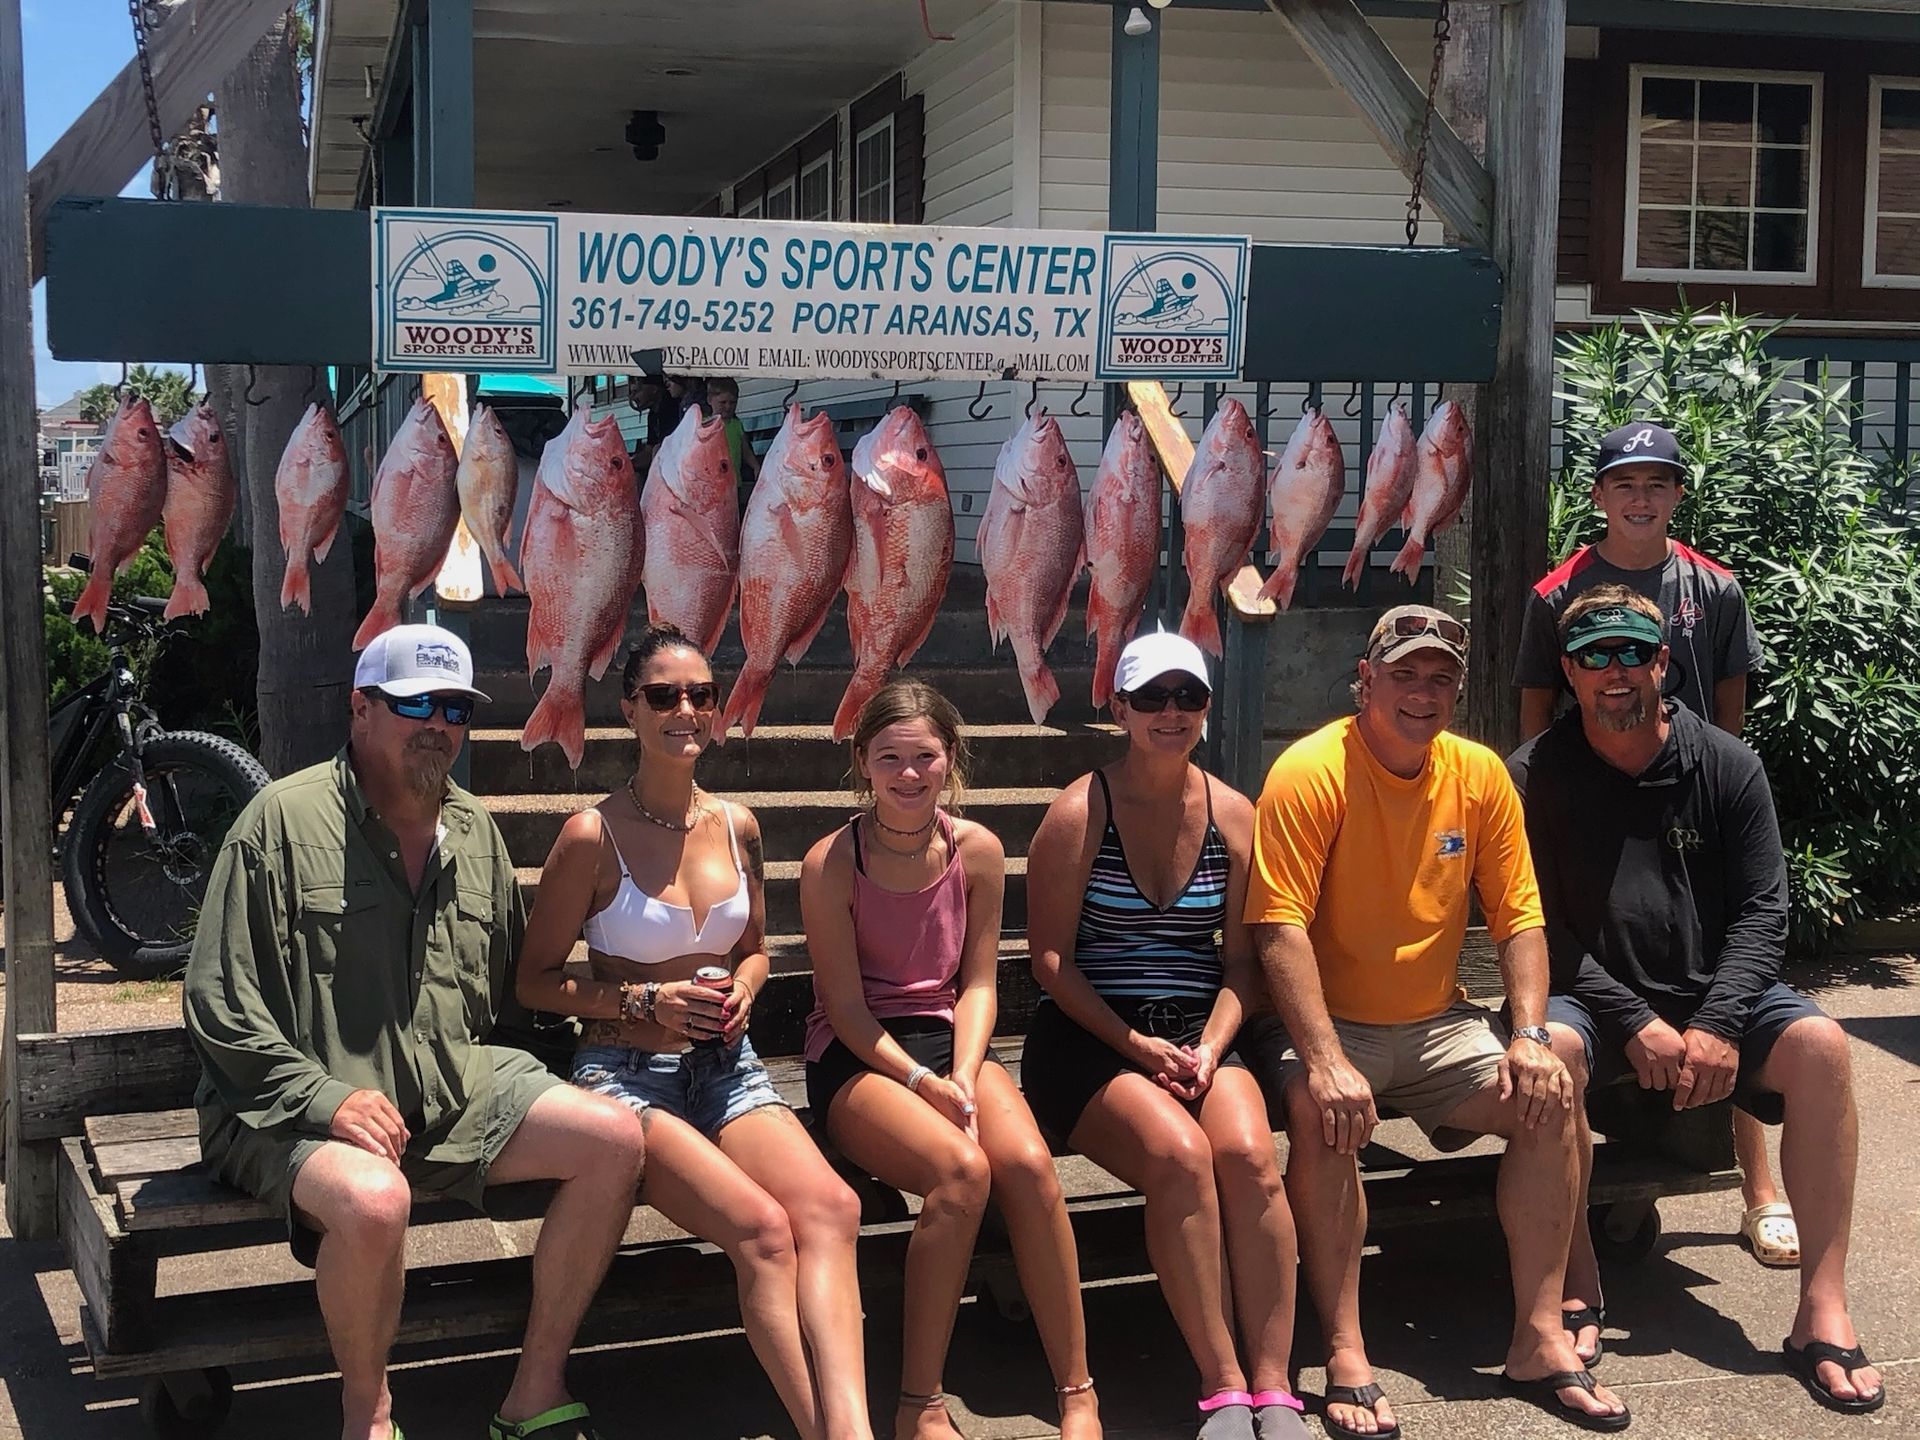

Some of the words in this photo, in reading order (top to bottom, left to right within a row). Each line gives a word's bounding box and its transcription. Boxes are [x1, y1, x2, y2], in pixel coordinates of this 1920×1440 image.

[578, 231, 770, 289] WOODY'S
[781, 237, 935, 293] SPORTS
[946, 242, 1097, 296] CENTER
[568, 296, 775, 333] 361-749-5252
[792, 302, 881, 335] PORT
[883, 304, 1040, 344] ARANSAS,
[1053, 307, 1092, 338] TX
[405, 326, 533, 345] WOODY'S
[403, 344, 466, 355] SPORTS
[470, 344, 537, 355] CENTER
[1120, 337, 1222, 355] WOODY'S
[758, 348, 811, 368] EMAIL:
[1117, 353, 1168, 363] SPORTS
[1170, 353, 1223, 363] CENTER
